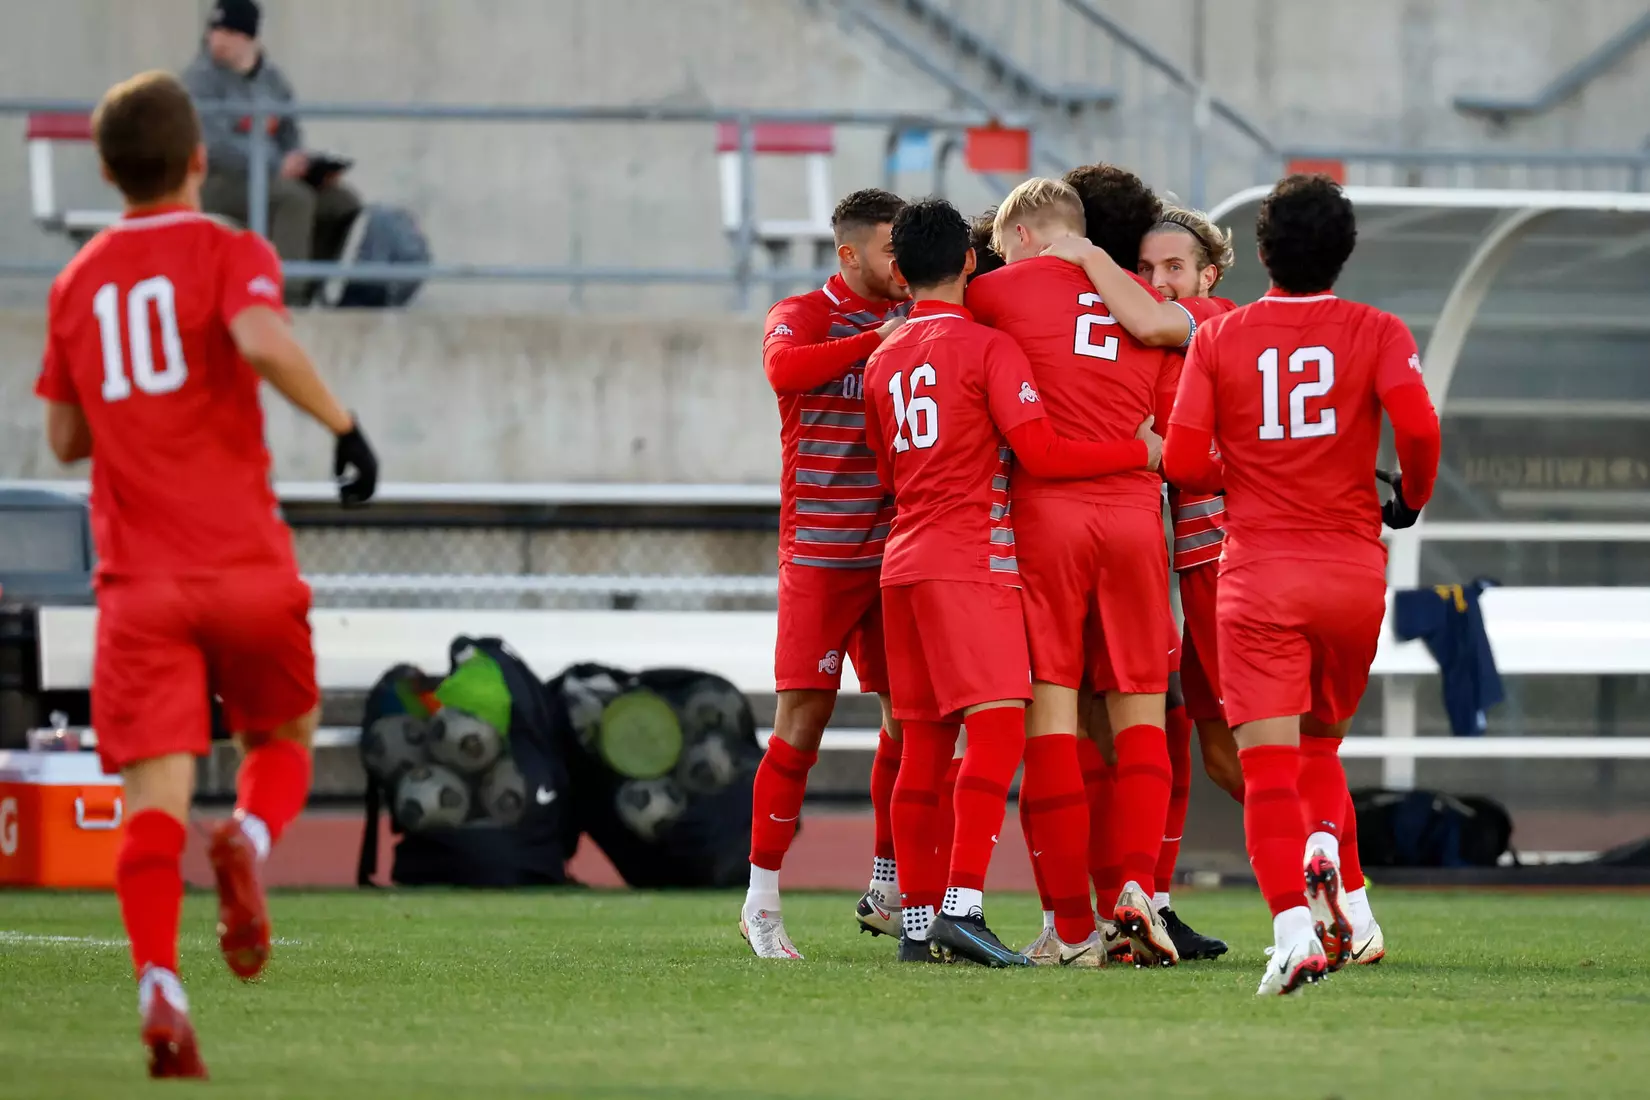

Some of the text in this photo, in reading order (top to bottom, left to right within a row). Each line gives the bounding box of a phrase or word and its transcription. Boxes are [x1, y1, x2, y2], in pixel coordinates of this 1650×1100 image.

[93, 275, 189, 403] 10
[1073, 291, 1120, 362] 2
[888, 362, 940, 453] 16
[1257, 345, 1336, 440] 12
